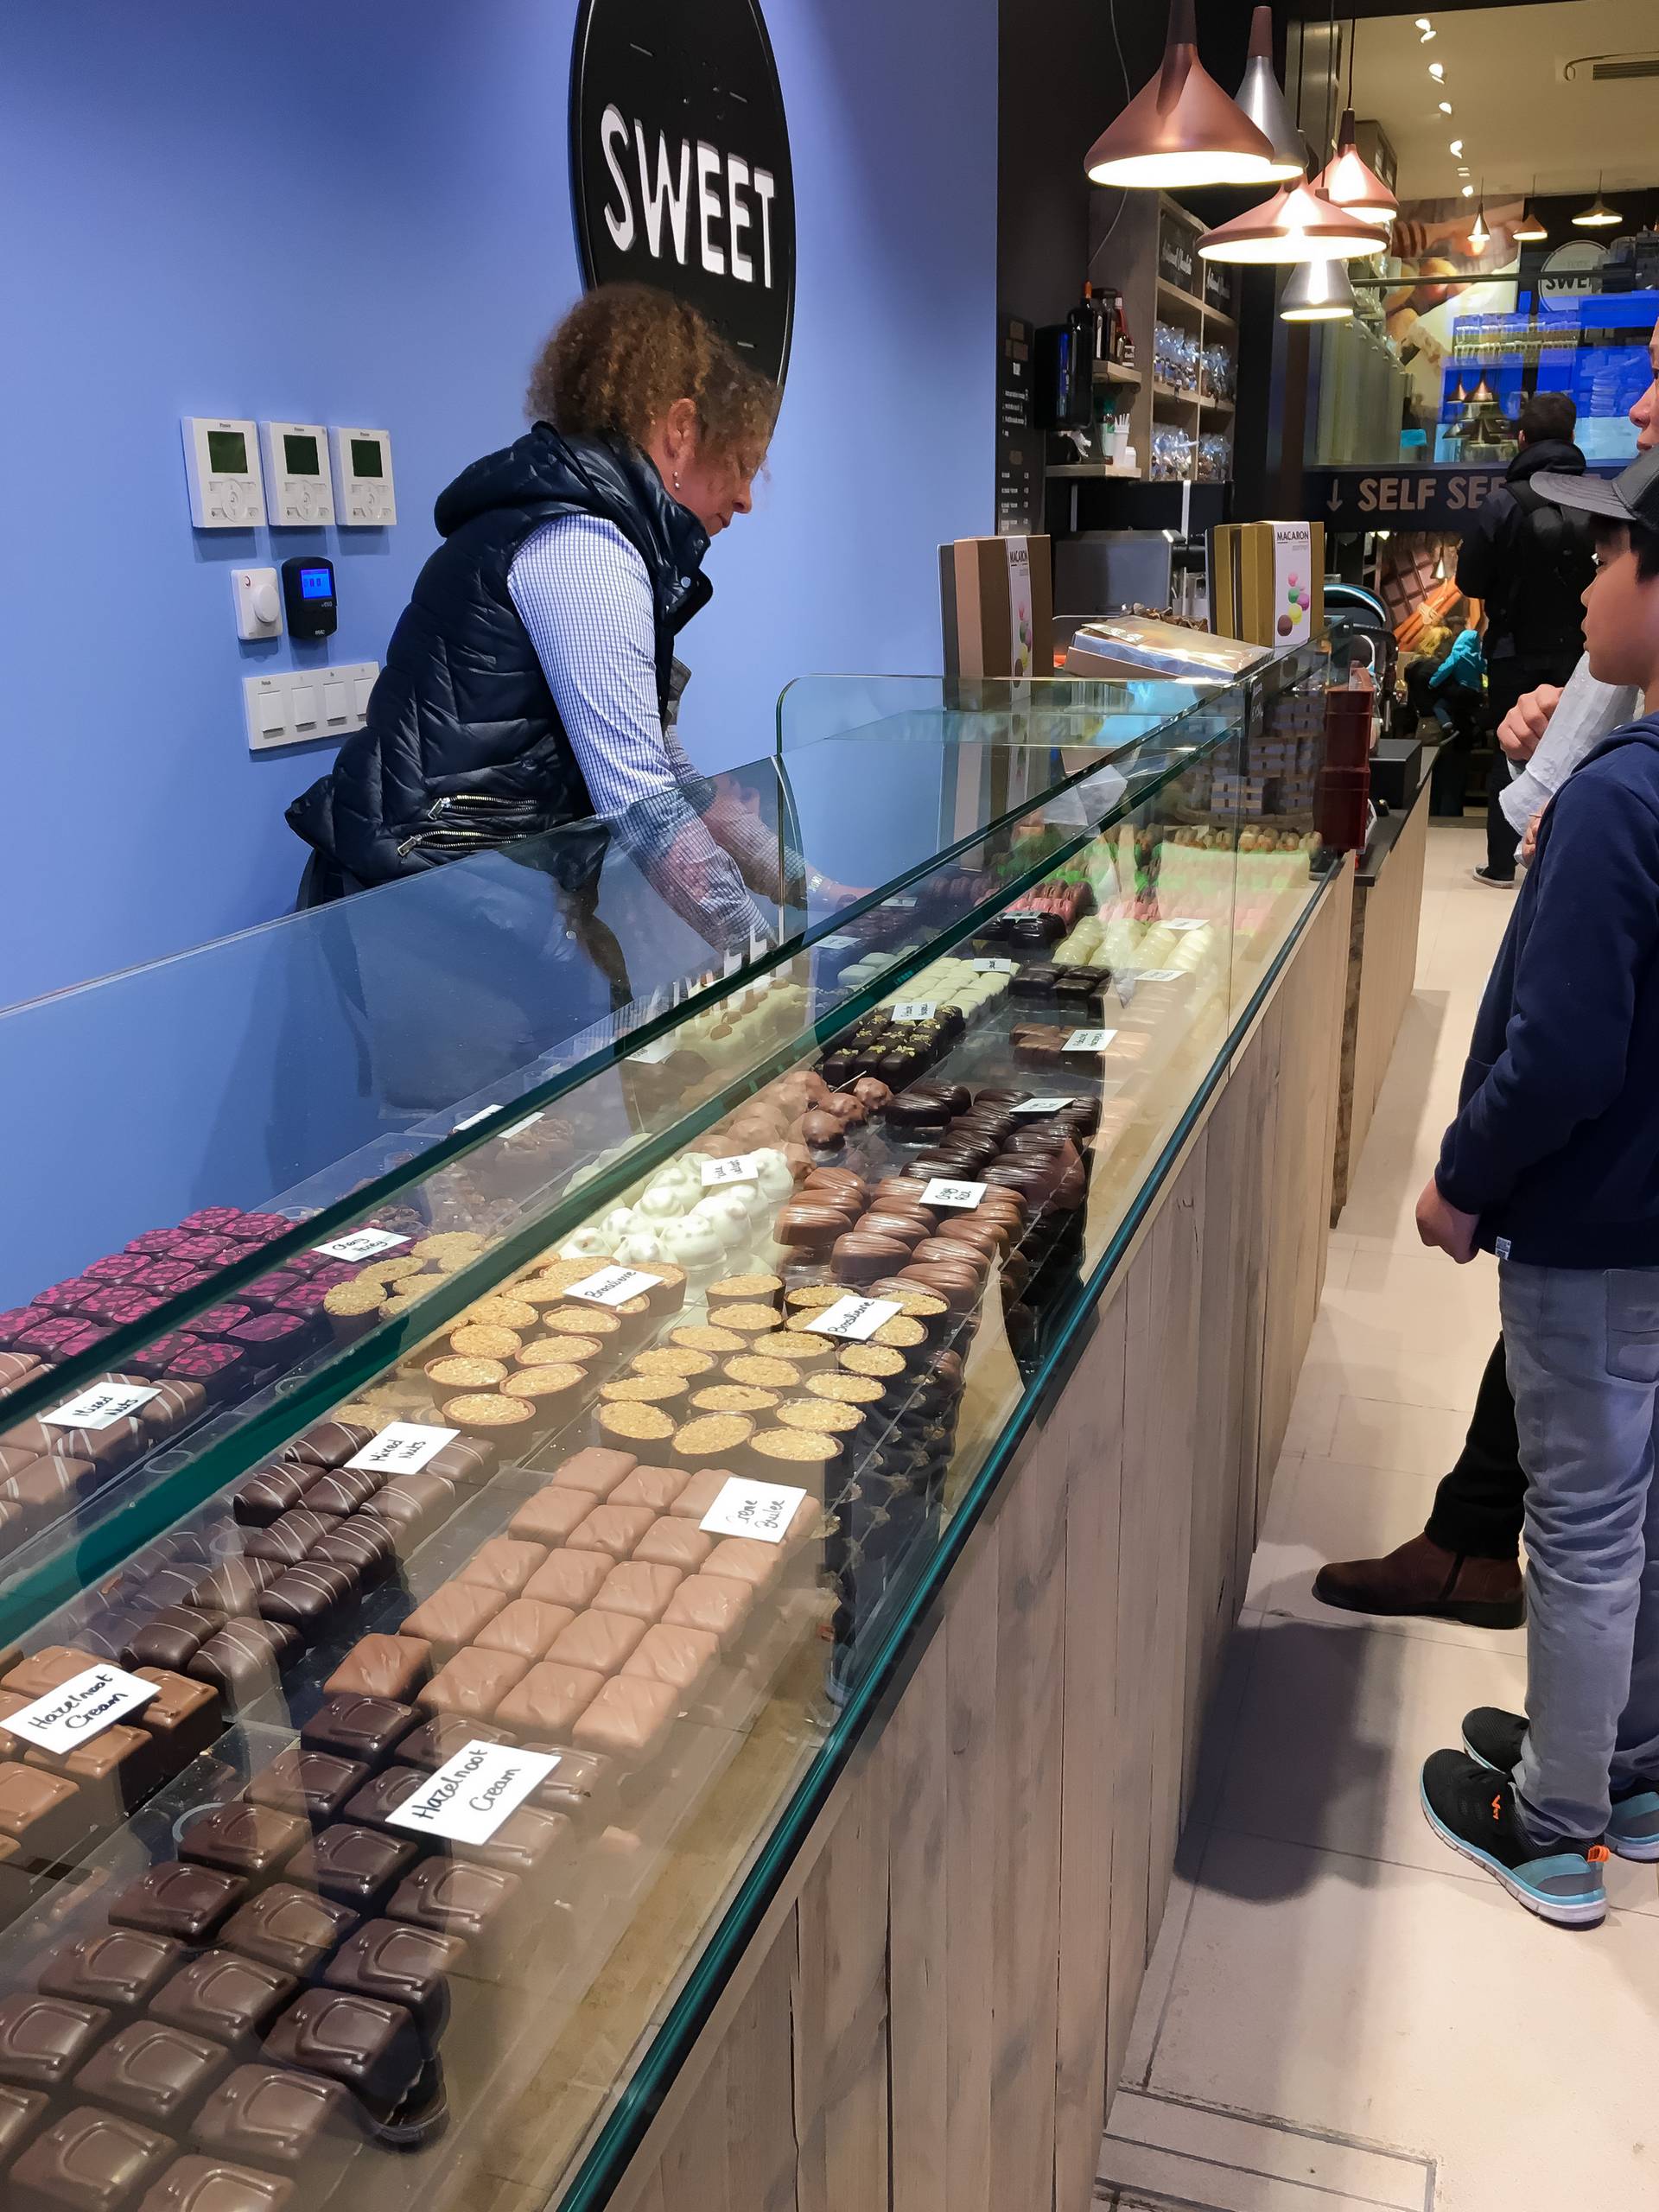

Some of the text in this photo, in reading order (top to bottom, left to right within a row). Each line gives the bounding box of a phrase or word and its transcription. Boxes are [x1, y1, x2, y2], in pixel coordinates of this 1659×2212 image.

[601, 102, 777, 289] SWEET
[1544, 276, 1592, 290] SWE
[1357, 478, 1438, 512] SELF
[1276, 531, 1309, 542] MACARON
[72, 1395, 113, 1417] Mixed
[103, 1399, 138, 1416] Nuts
[368, 1439, 404, 1462] Mixed
[27, 1673, 114, 1730] Hazelnoot
[64, 1692, 129, 1729] Cream
[411, 1749, 488, 1820] Hazelnoot
[468, 1768, 521, 1811] Cream
